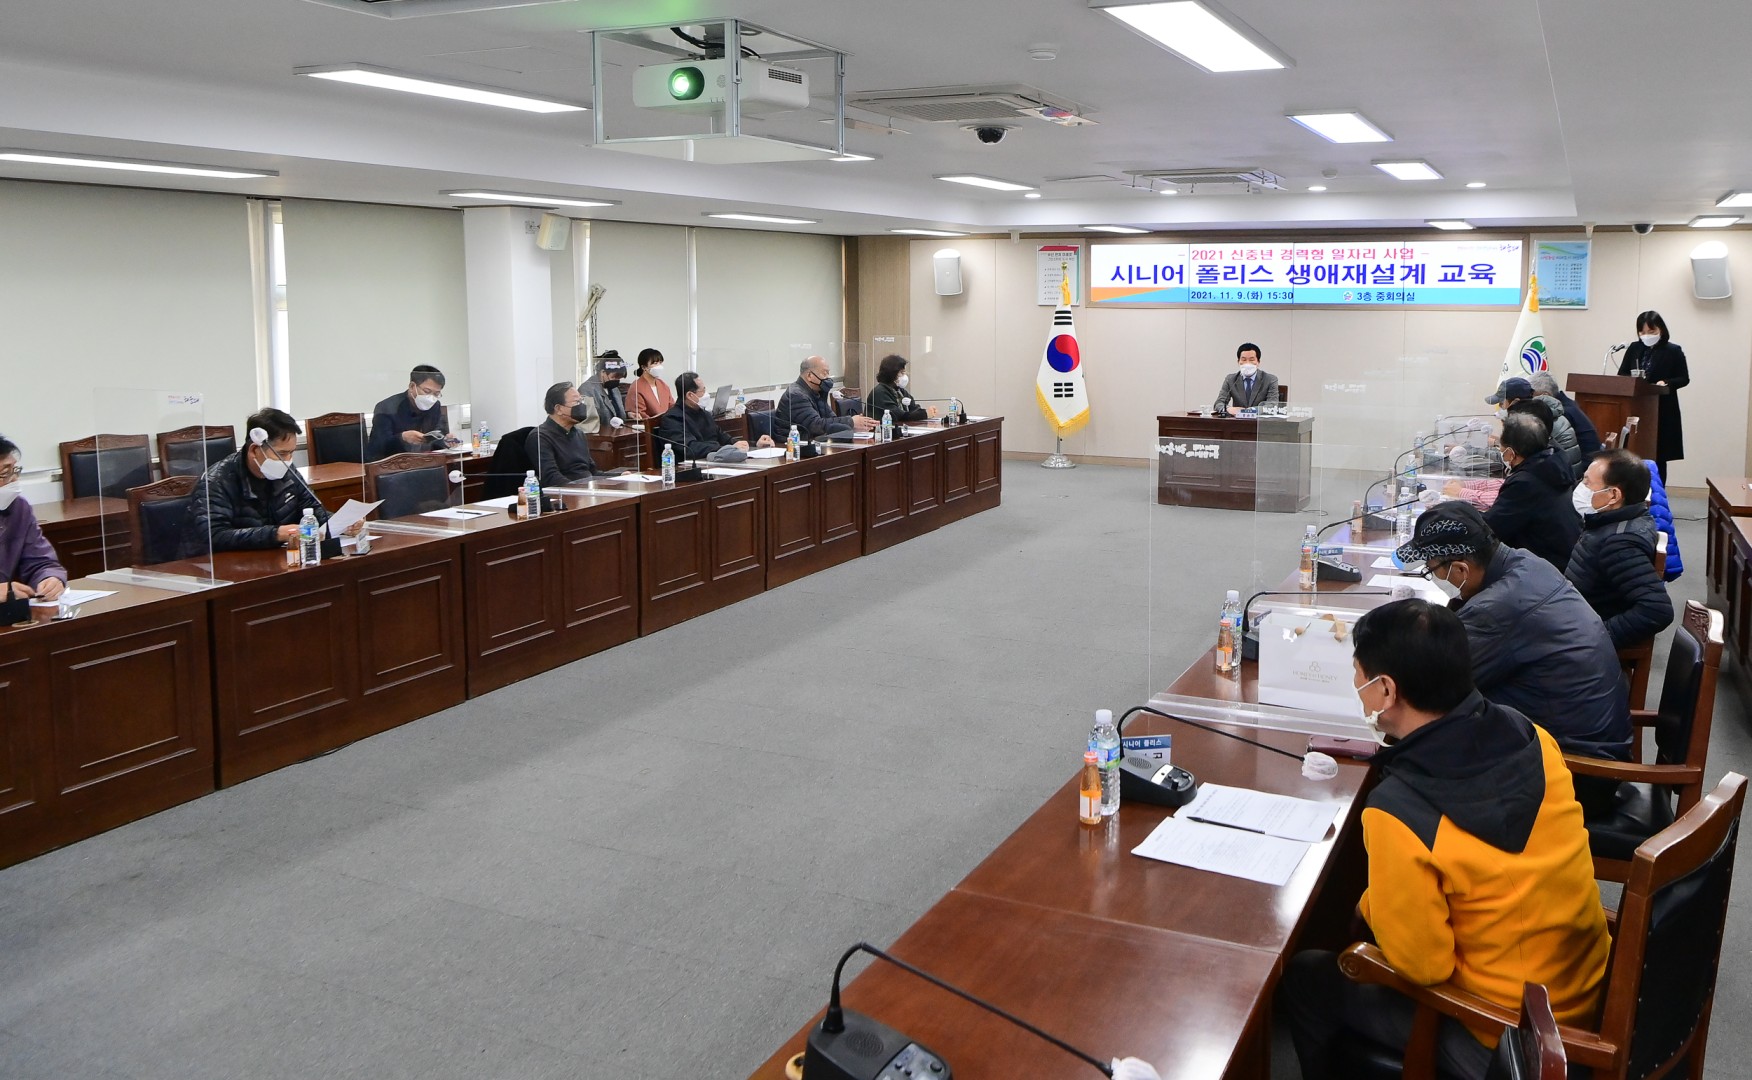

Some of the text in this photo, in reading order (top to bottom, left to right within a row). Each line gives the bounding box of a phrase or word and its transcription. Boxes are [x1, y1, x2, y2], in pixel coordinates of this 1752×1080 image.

[1191, 247, 1414, 261] 2021 신중년 경력형 일자리 사업
[1110, 263, 1497, 285] 시니어 폴리스 생애재설계 교육
[1191, 291, 1216, 300] 2021.
[1220, 291, 1234, 300] 11.
[1267, 291, 1294, 300] 15:30
[1357, 291, 1415, 302] 3층 중회의실
[1122, 739, 1141, 748] 시니어
